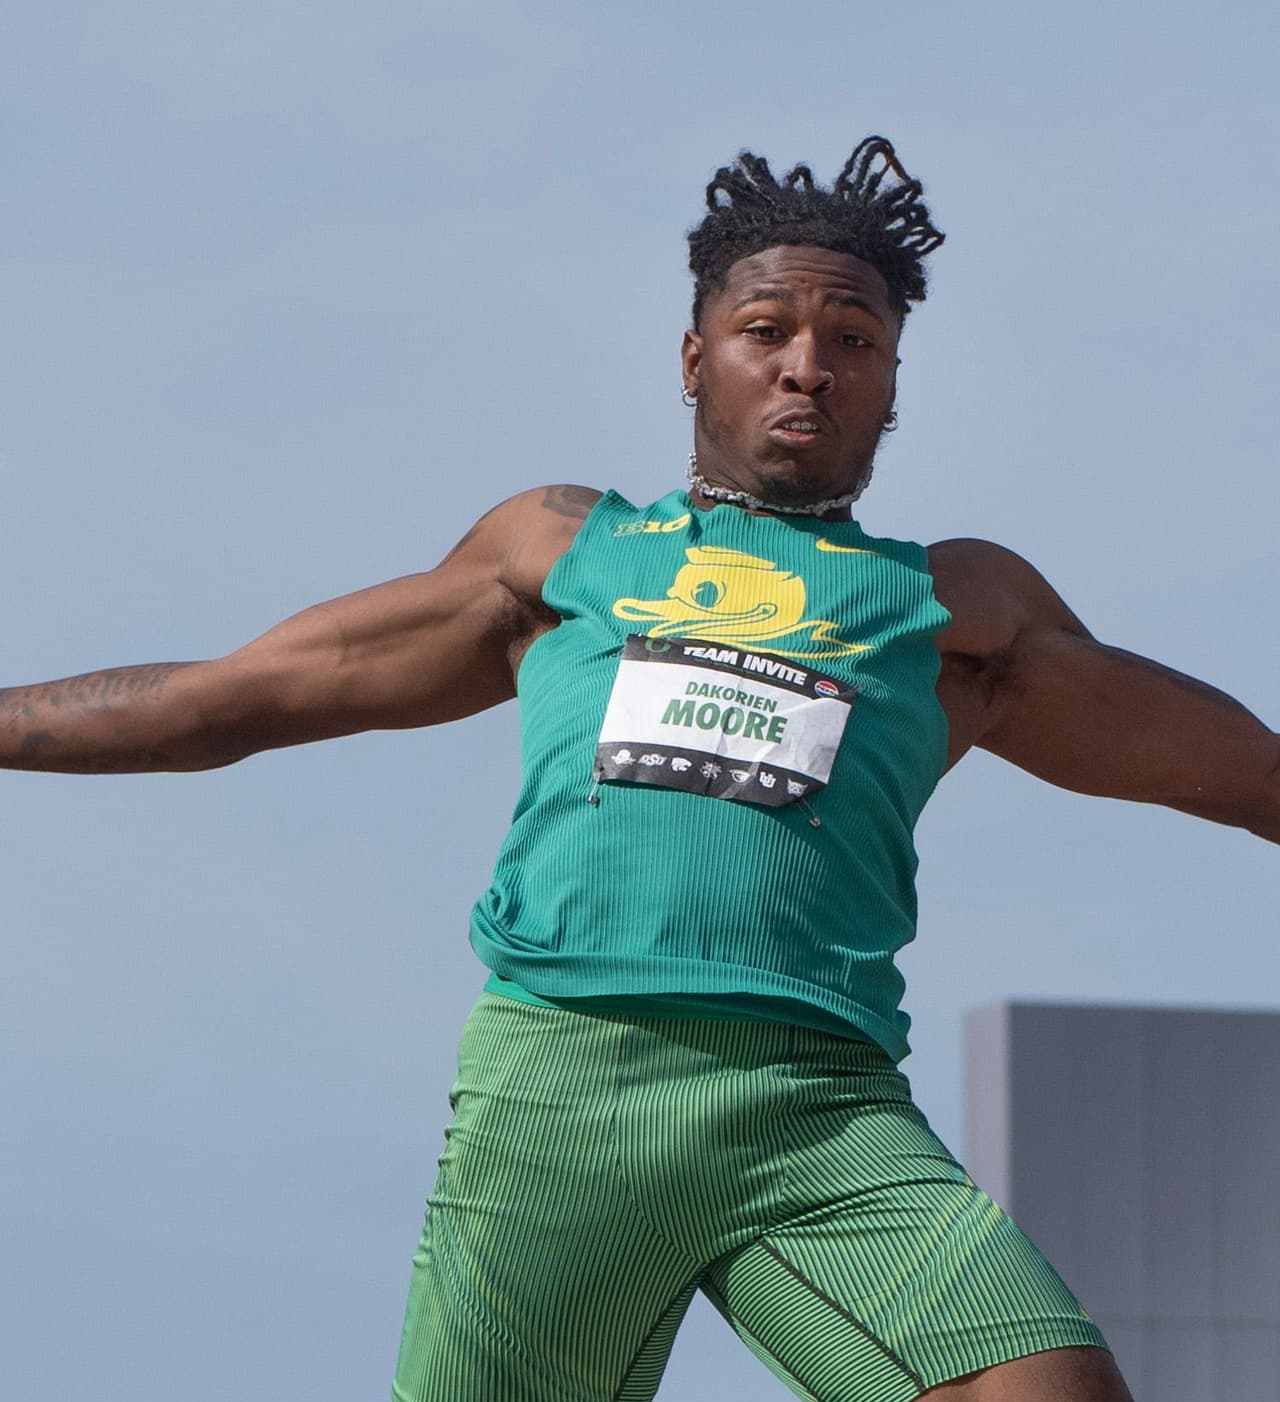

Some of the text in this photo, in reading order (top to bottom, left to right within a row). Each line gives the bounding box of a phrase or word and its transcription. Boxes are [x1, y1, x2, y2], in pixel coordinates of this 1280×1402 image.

[683, 646, 809, 686] TEAM INVITE
[685, 681, 778, 713] DAKORIEN
[660, 699, 789, 744] MOORE
